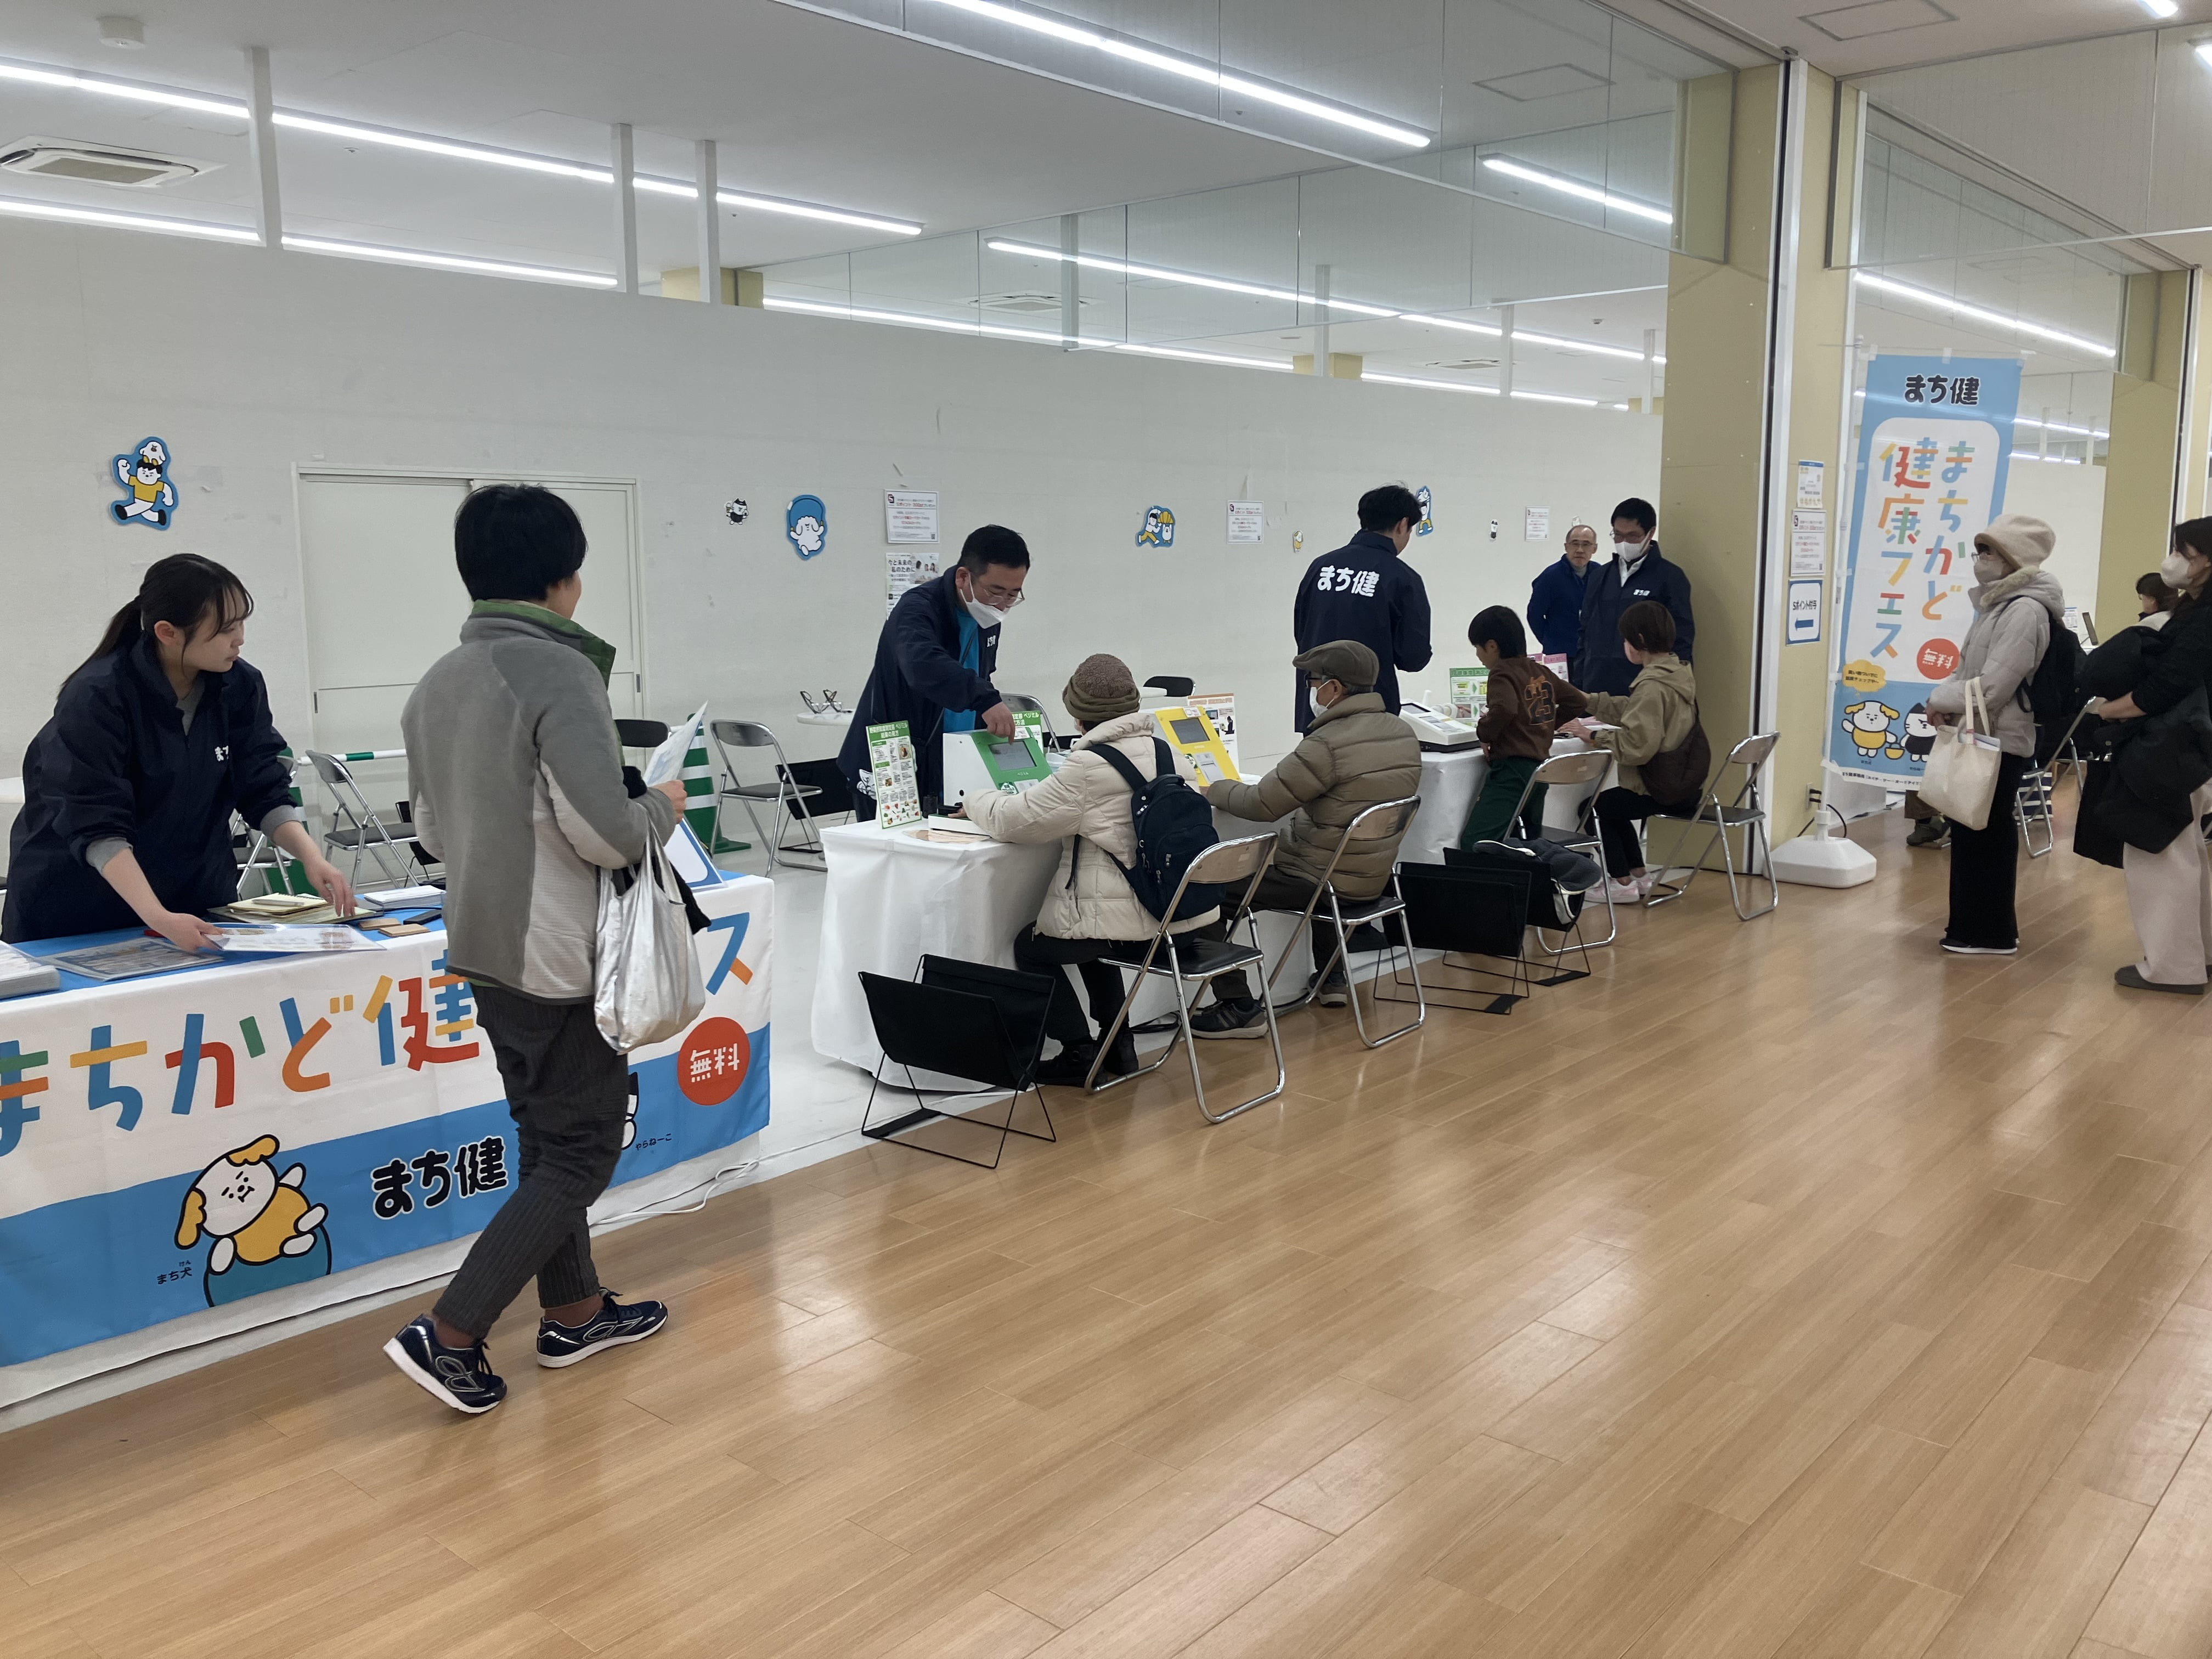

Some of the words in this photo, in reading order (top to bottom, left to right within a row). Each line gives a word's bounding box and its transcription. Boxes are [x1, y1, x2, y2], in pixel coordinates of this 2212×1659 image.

[1905, 375, 1979, 405] まち健
[1922, 441, 1975, 620] まちかど
[1870, 437, 1939, 658] 健康フェス
[1317, 565, 1380, 597] まち健
[1922, 648, 1954, 669] 無料
[690, 1043, 740, 1083] 無料
[636, 1133, 672, 1151] やらねーこ
[371, 1136, 509, 1220] まち健
[157, 1267, 193, 1285] まち犬
